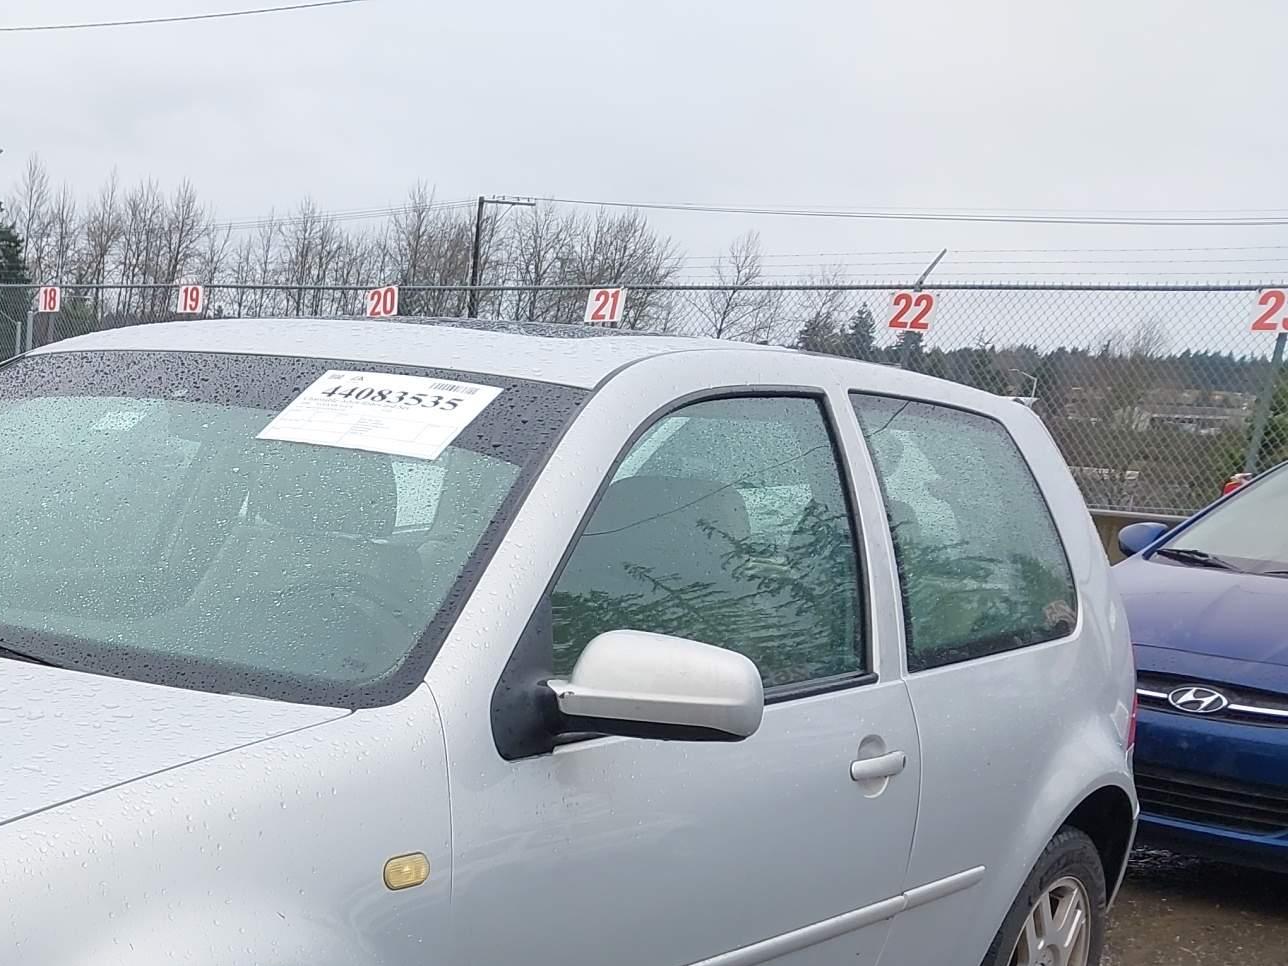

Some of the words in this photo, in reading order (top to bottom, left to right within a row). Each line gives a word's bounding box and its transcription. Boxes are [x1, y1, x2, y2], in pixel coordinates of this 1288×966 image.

[43, 288, 56, 310] 18
[183, 286, 200, 312] 19
[369, 286, 395, 317] 20
[591, 289, 621, 321] 21
[888, 292, 934, 330] 22
[1251, 290, 1288, 331] 2
[321, 384, 464, 411] 44083535
